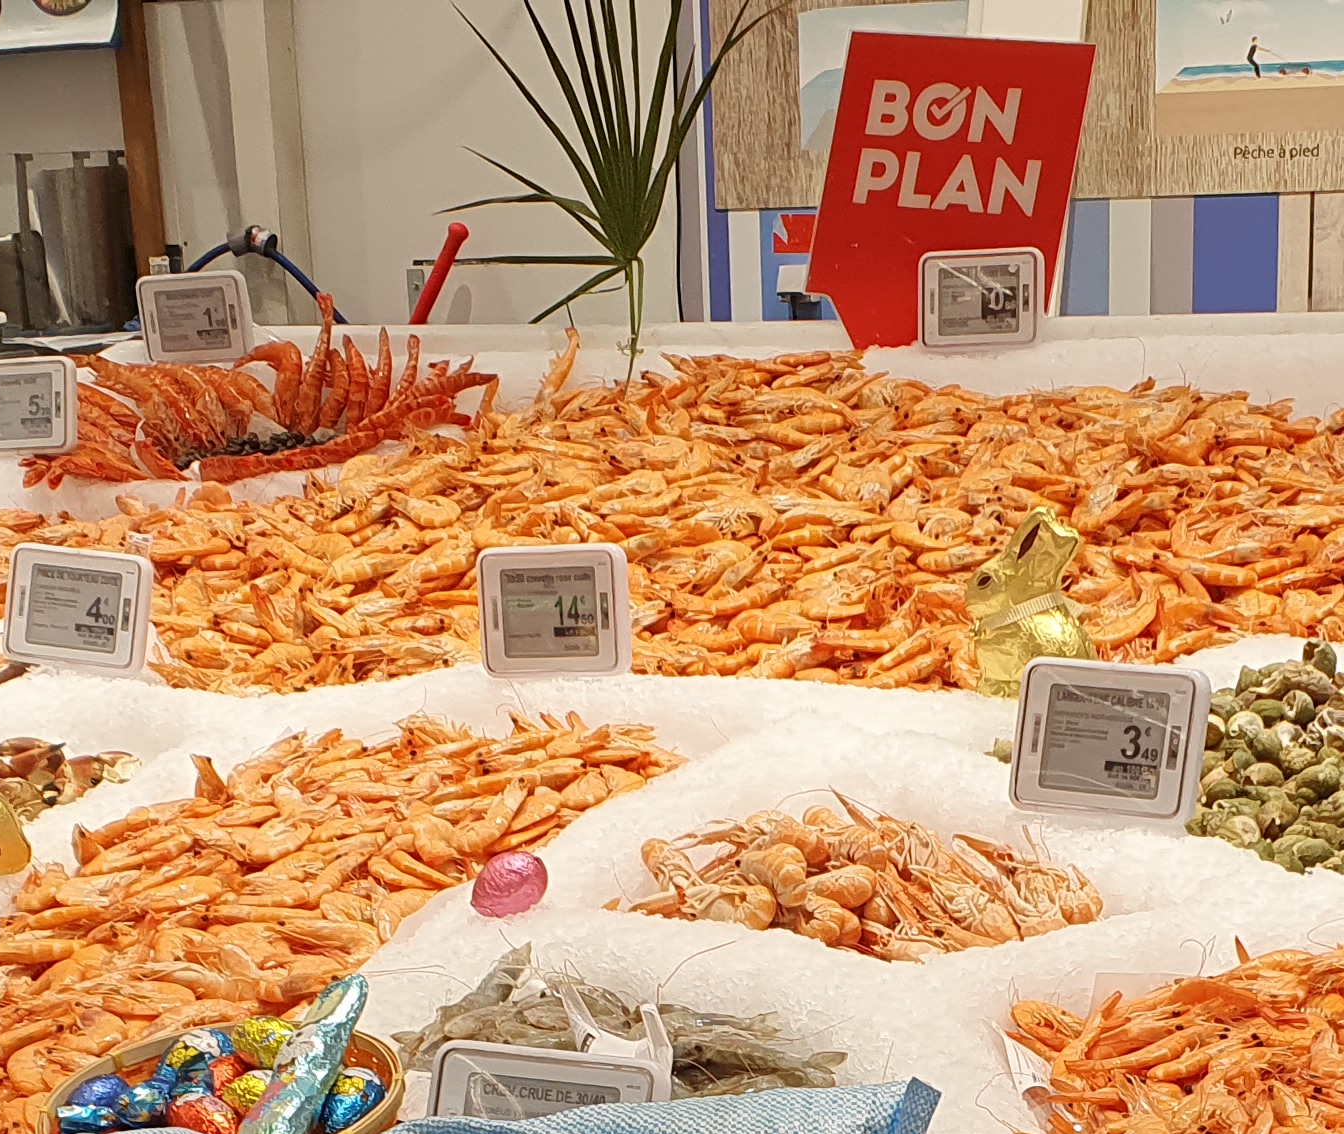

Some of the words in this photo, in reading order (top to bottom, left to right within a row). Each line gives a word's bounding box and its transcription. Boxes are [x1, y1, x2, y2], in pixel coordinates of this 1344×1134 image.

[865, 79, 1022, 145] BON
[1233, 144, 1275, 160] Pêche
[1278, 145, 1287, 159] à
[1289, 143, 1320, 162] pied
[852, 147, 1042, 217] PLAN
[554, 595, 581, 627] 14
[1120, 725, 1142, 760] 3
